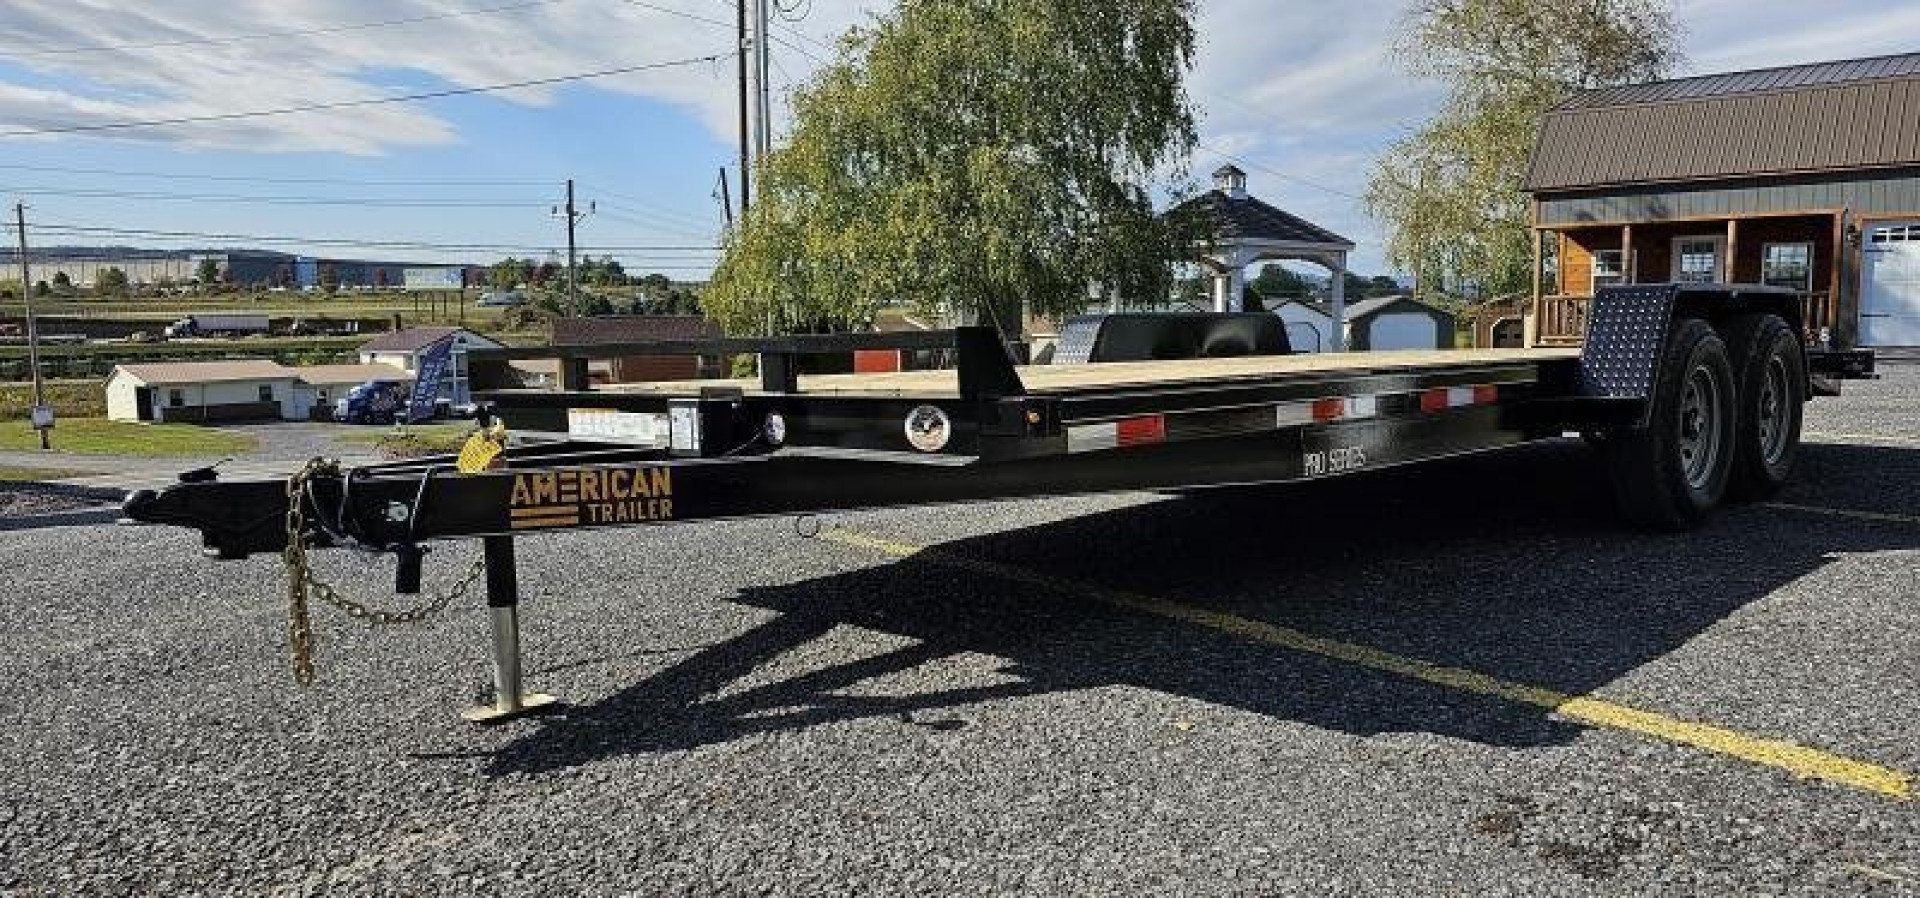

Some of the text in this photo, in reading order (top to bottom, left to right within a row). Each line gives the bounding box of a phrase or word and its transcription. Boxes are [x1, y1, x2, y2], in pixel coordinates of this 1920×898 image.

[1303, 445, 1366, 476] PRO SERIES
[511, 467, 672, 504] AMERICAN
[587, 499, 673, 522] TRAILER
